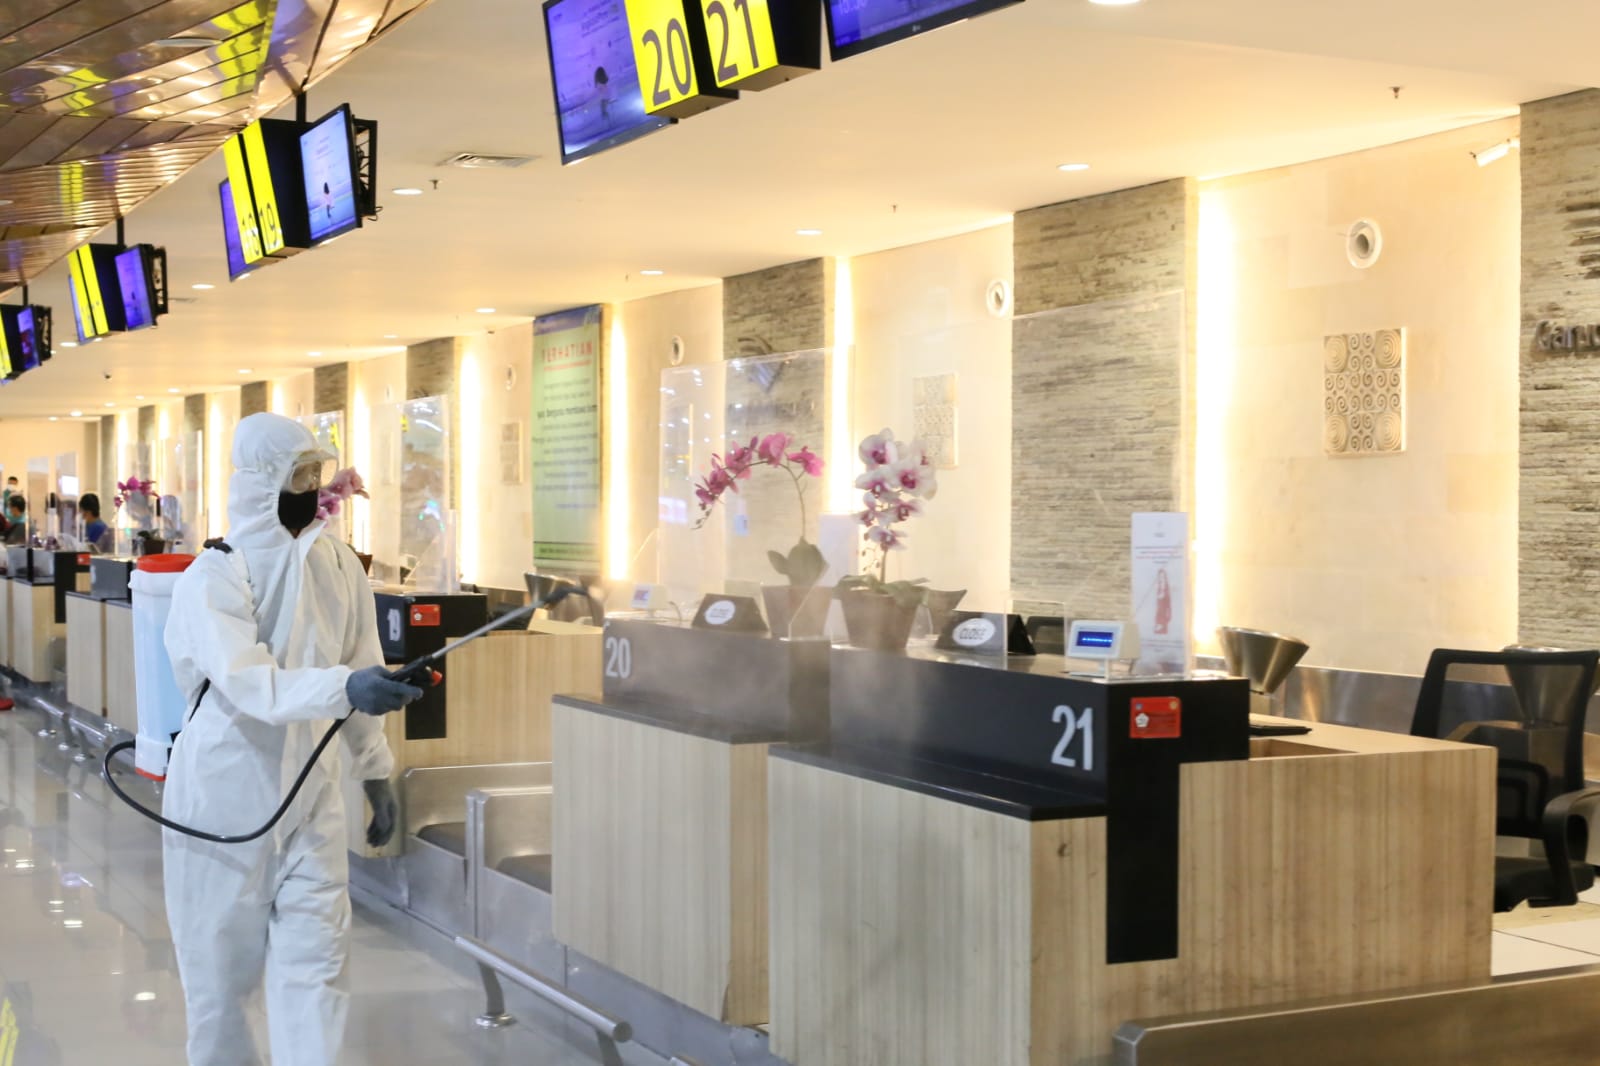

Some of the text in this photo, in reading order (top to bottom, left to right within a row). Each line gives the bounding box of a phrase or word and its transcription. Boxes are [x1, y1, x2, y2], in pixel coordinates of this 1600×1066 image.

[642, 18, 692, 106] 20
[706, 0, 759, 83] 21
[258, 203, 278, 250] 19
[606, 637, 631, 678] 20
[1051, 705, 1094, 772] 21
